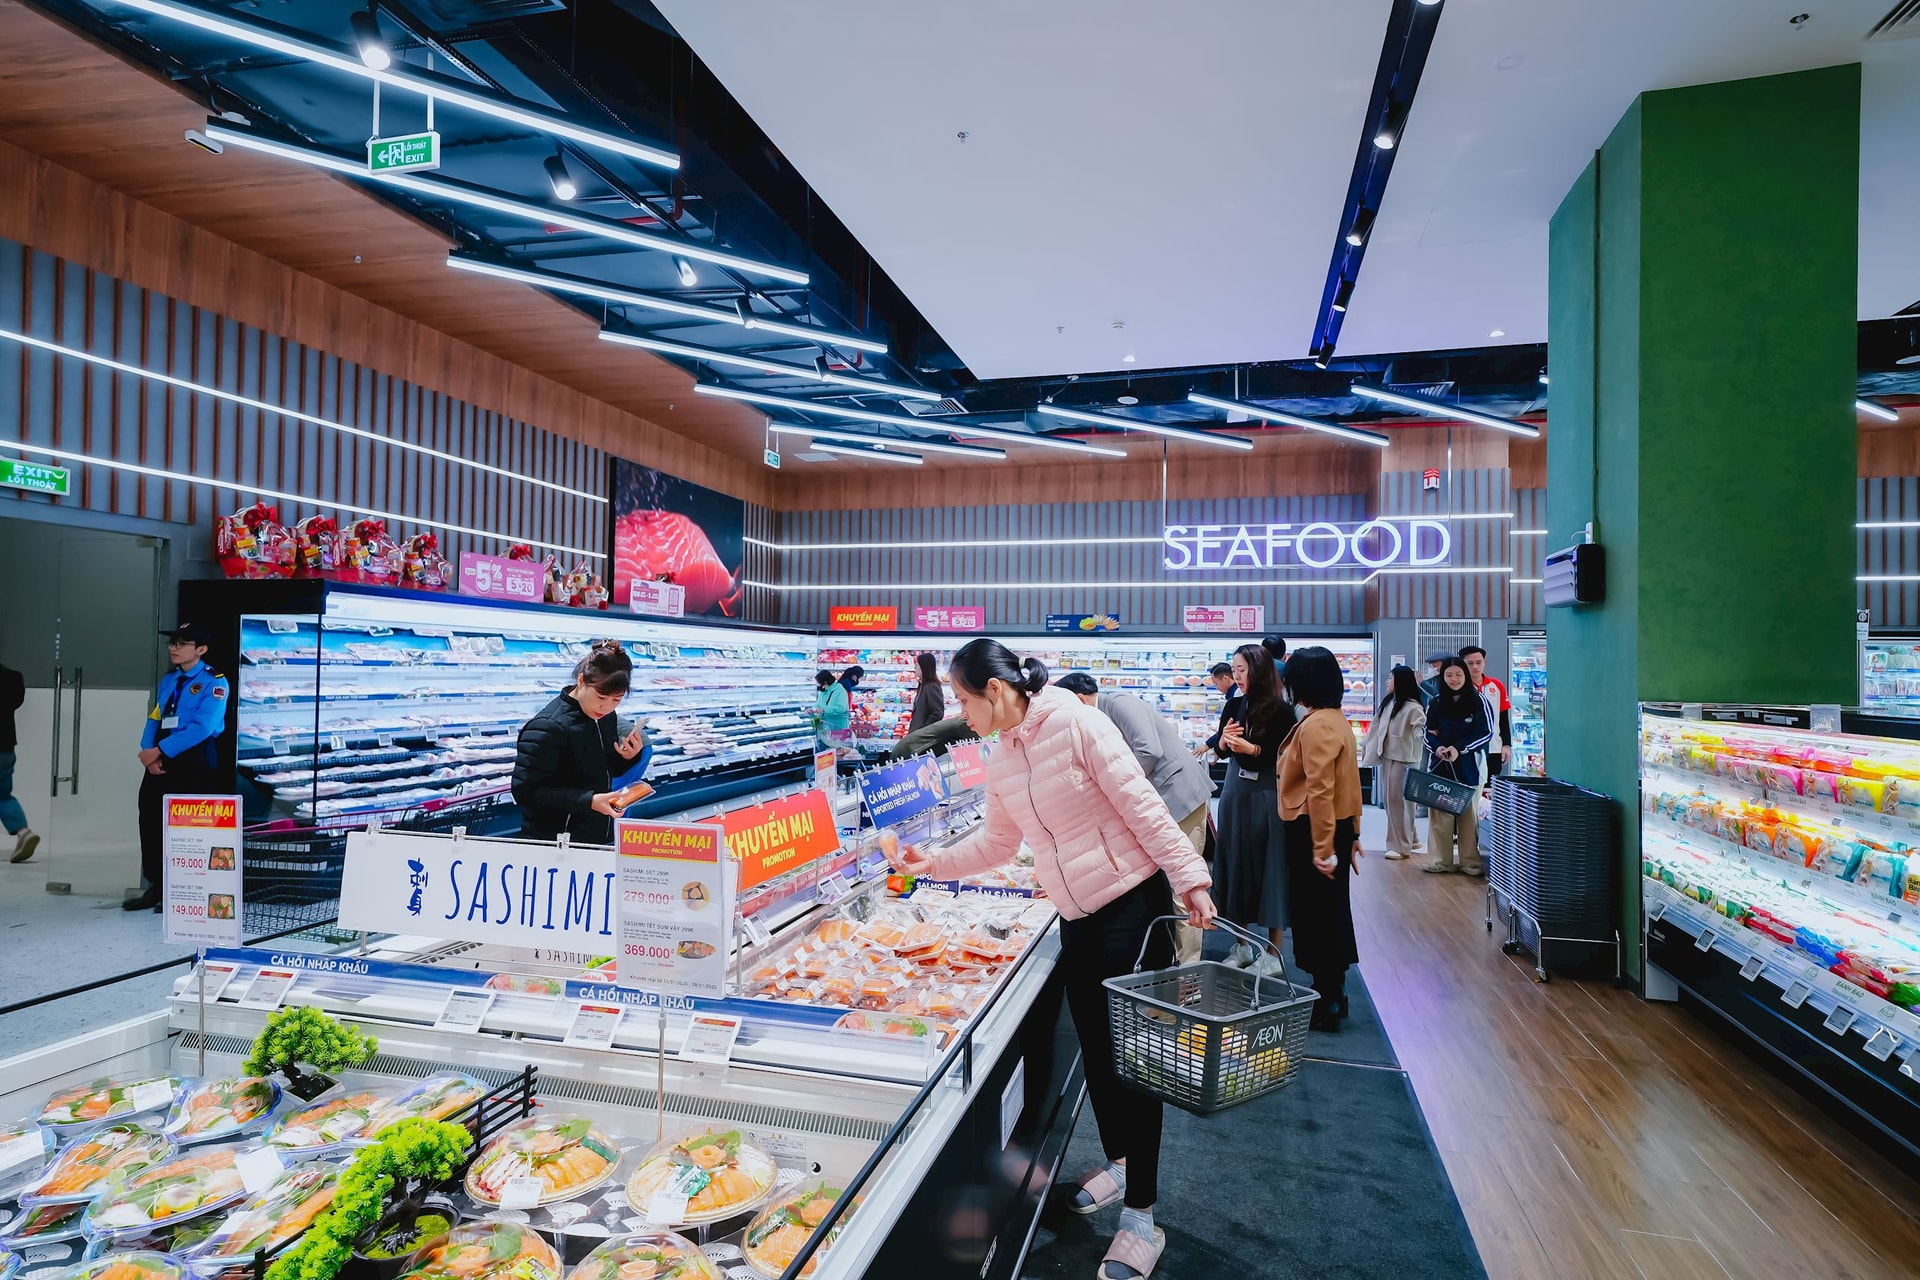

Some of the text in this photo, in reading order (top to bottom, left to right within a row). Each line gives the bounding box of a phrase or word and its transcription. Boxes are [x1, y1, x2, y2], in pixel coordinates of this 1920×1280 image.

[405, 153, 425, 163] EXIT
[13, 463, 53, 479] EXIT
[27, 478, 57, 490] THOÁT
[1163, 520, 1451, 569] SEAFOOD
[836, 611, 890, 624] KHUYẾN MẠI
[868, 777, 916, 805] CÁ HỒI NHẬP KHẨU
[171, 800, 234, 821] KHUYẾN MẠI
[873, 802, 894, 816] IMPORTED
[893, 797, 906, 809] FRESH
[905, 791, 920, 803] SALMON
[623, 828, 712, 852] KHUYẾN MẠI
[724, 810, 814, 859] KHUYẾN MẠI
[762, 847, 796, 869] PROMOTION
[916, 882, 949, 890] SALMON
[445, 860, 616, 936] SASHIMI
[623, 920, 644, 928] SASHIMI
[657, 923, 668, 931] SUM
[270, 953, 369, 975] CÁ HỒI NHẬP KHẨU
[579, 986, 596, 1000] CÁ
[598, 986, 620, 1001] HỒI
[622, 991, 657, 1007] NHẬP
